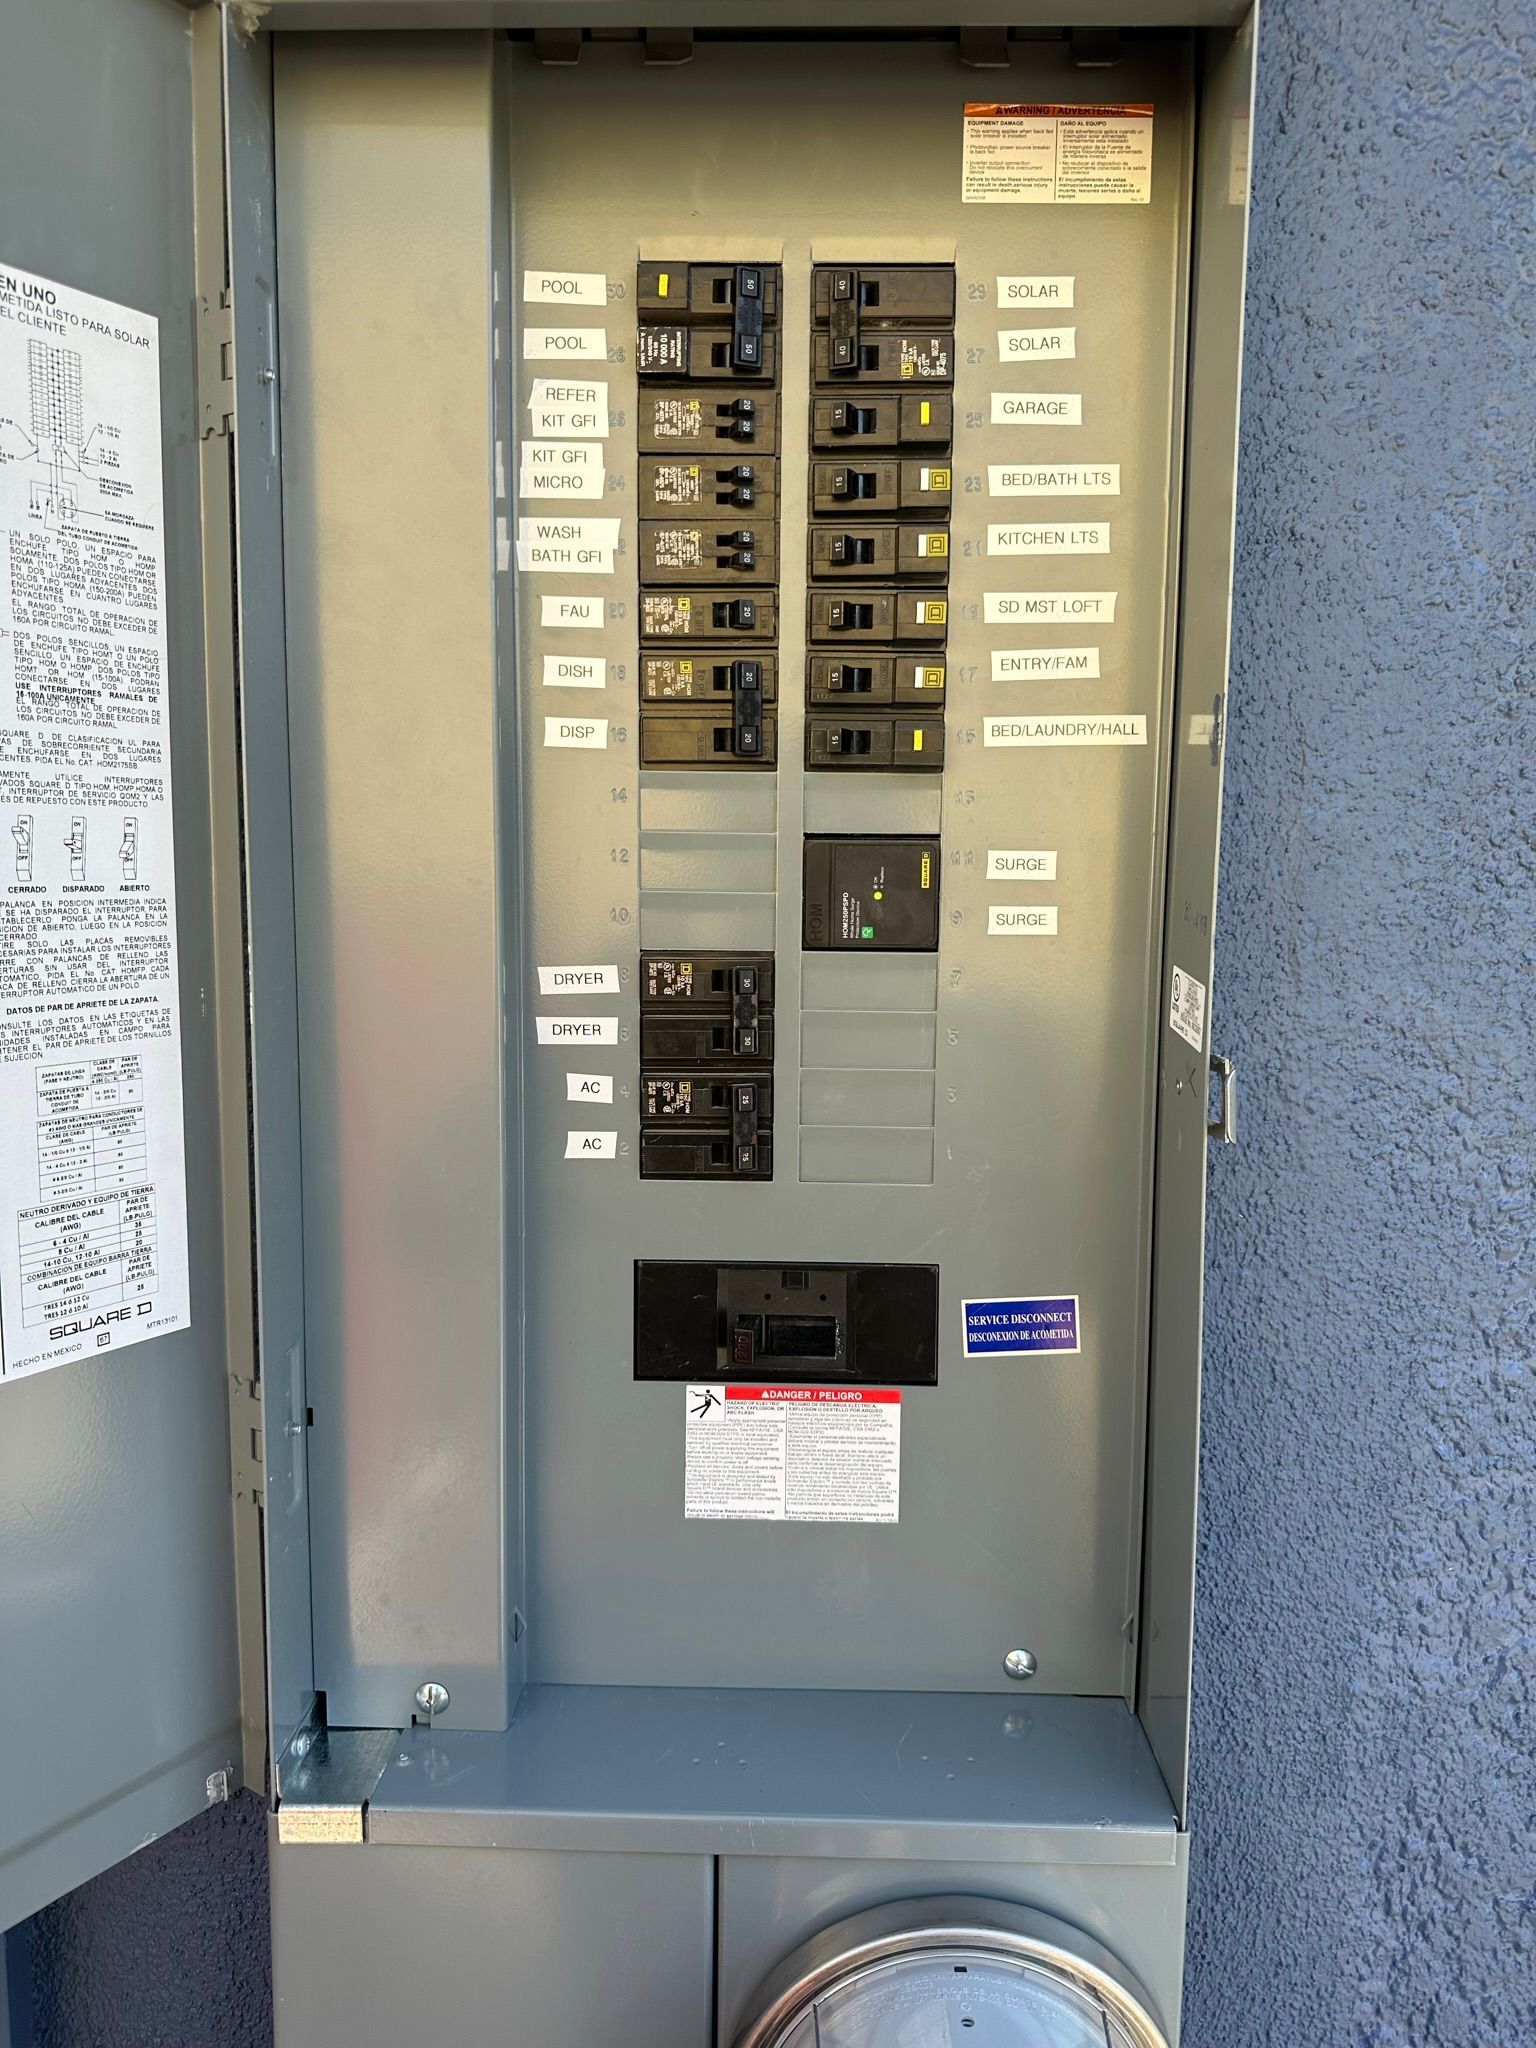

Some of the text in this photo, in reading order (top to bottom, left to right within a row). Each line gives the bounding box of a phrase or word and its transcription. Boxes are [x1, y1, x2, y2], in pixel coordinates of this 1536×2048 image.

[1004, 106, 1050, 115] WARNING
[541, 279, 583, 294] POOL
[747, 279, 755, 290] 50
[838, 279, 846, 291] 40
[968, 284, 986, 299] 29
[1007, 284, 1060, 299] SOLAR
[23, 282, 56, 305] UNO
[18, 311, 67, 336] CLIENTE
[46, 305, 79, 325] LISTO
[82, 318, 112, 336] PARA
[115, 329, 150, 349] SOLAR
[545, 336, 587, 350] POOL
[660, 333, 668, 343] 10
[1008, 336, 1061, 352] SOLAR
[660, 344, 668, 358] 000
[746, 343, 753, 354] 50
[839, 345, 847, 356] 40
[967, 348, 985, 364] 27
[546, 387, 596, 402] REFER
[743, 400, 751, 410] 20
[1002, 401, 1069, 416] GARAGE
[542, 414, 596, 427] KIT GFI
[835, 408, 842, 419] 15
[965, 412, 983, 428] 25
[743, 421, 751, 432] 20
[533, 449, 587, 463] KIT GFI
[743, 466, 750, 477] 20
[533, 475, 583, 489] MICRO
[608, 474, 625, 491] 24
[836, 477, 843, 487] 15
[964, 476, 982, 492] 23
[1001, 472, 1112, 487] BED/BATH LTS
[742, 489, 750, 500] 20
[536, 525, 582, 539] WASH
[743, 532, 750, 543] 20
[997, 530, 1099, 546] KITCHEN LTS
[835, 541, 842, 552] 15
[531, 548, 602, 563] BATH GFI
[743, 552, 751, 563] 20
[560, 604, 590, 618] FAU
[608, 603, 627, 618] 20
[743, 606, 751, 618] 20
[833, 608, 840, 619] 15
[998, 599, 1103, 614] SD MST LOFT
[557, 664, 593, 678] DISH
[1000, 656, 1088, 672] ENTRY/FAM
[745, 672, 753, 683] 20
[832, 672, 839, 682] 15
[15, 682, 30, 690] USE
[39, 684, 102, 697] INTERRUPTORES
[109, 692, 144, 702] RAMALES
[560, 725, 595, 739] DISP
[990, 723, 1140, 738] BED/LAUNDRY/HALL
[744, 733, 752, 744] 20
[832, 735, 839, 746] 15
[610, 848, 630, 864] 12
[994, 858, 1047, 871] SURGE
[609, 908, 630, 925] 10
[996, 914, 1048, 926] SURGE
[554, 972, 604, 986] DRYER
[743, 977, 750, 989] 30
[6, 1007, 33, 1015] DATOS
[76, 1000, 107, 1009] APRIETE
[552, 1023, 601, 1036] DRYER
[744, 1036, 751, 1047] 30
[580, 1081, 601, 1094] AC
[742, 1095, 749, 1105] 25
[582, 1138, 602, 1150] AC
[742, 1152, 749, 1162] 25
[19, 1208, 49, 1219] NEUTRO
[51, 1200, 87, 1212] DERIVADO
[93, 1193, 119, 1204] EQUIPO
[131, 1186, 154, 1196] TIERRA
[125, 1203, 150, 1213] APRIETE
[126, 1197, 137, 1205] PAR
[35, 1208, 104, 1229] CALIBRE DEL CABLE
[60, 1222, 82, 1233] (AWG)
[50, 1301, 152, 1340] SQUARE D
[147, 1315, 178, 1329] MTR13101
[968, 1312, 1072, 1326] SERVICE DISCONNECT
[969, 1329, 1074, 1342] DESCONEXION DE ACOMETIDA
[12, 1343, 82, 1369] HECHO EN MEXICO
[769, 1390, 863, 1400] DANGER PELIGRO
